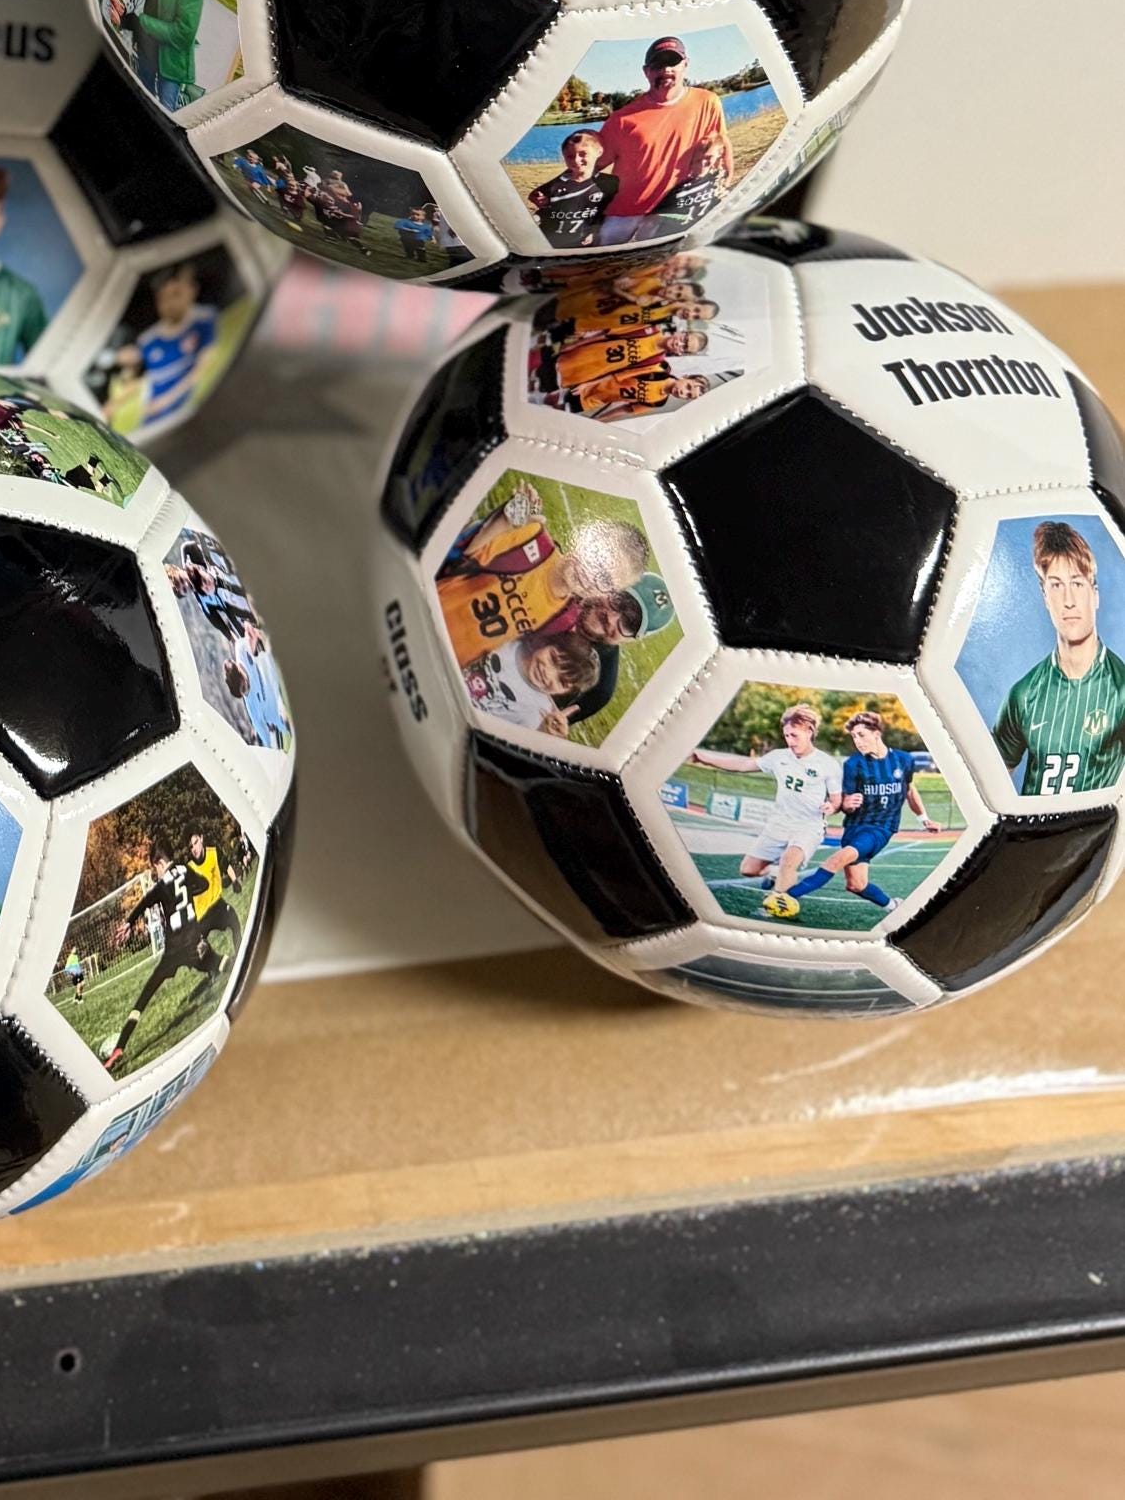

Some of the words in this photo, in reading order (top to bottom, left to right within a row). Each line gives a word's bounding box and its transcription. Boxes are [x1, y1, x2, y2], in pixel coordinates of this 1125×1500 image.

[852, 296, 1013, 342] Jackson
[882, 354, 1062, 406] Thornton
[472, 592, 508, 638] 30
[785, 776, 804, 793] 22
[1040, 754, 1081, 796] 22
